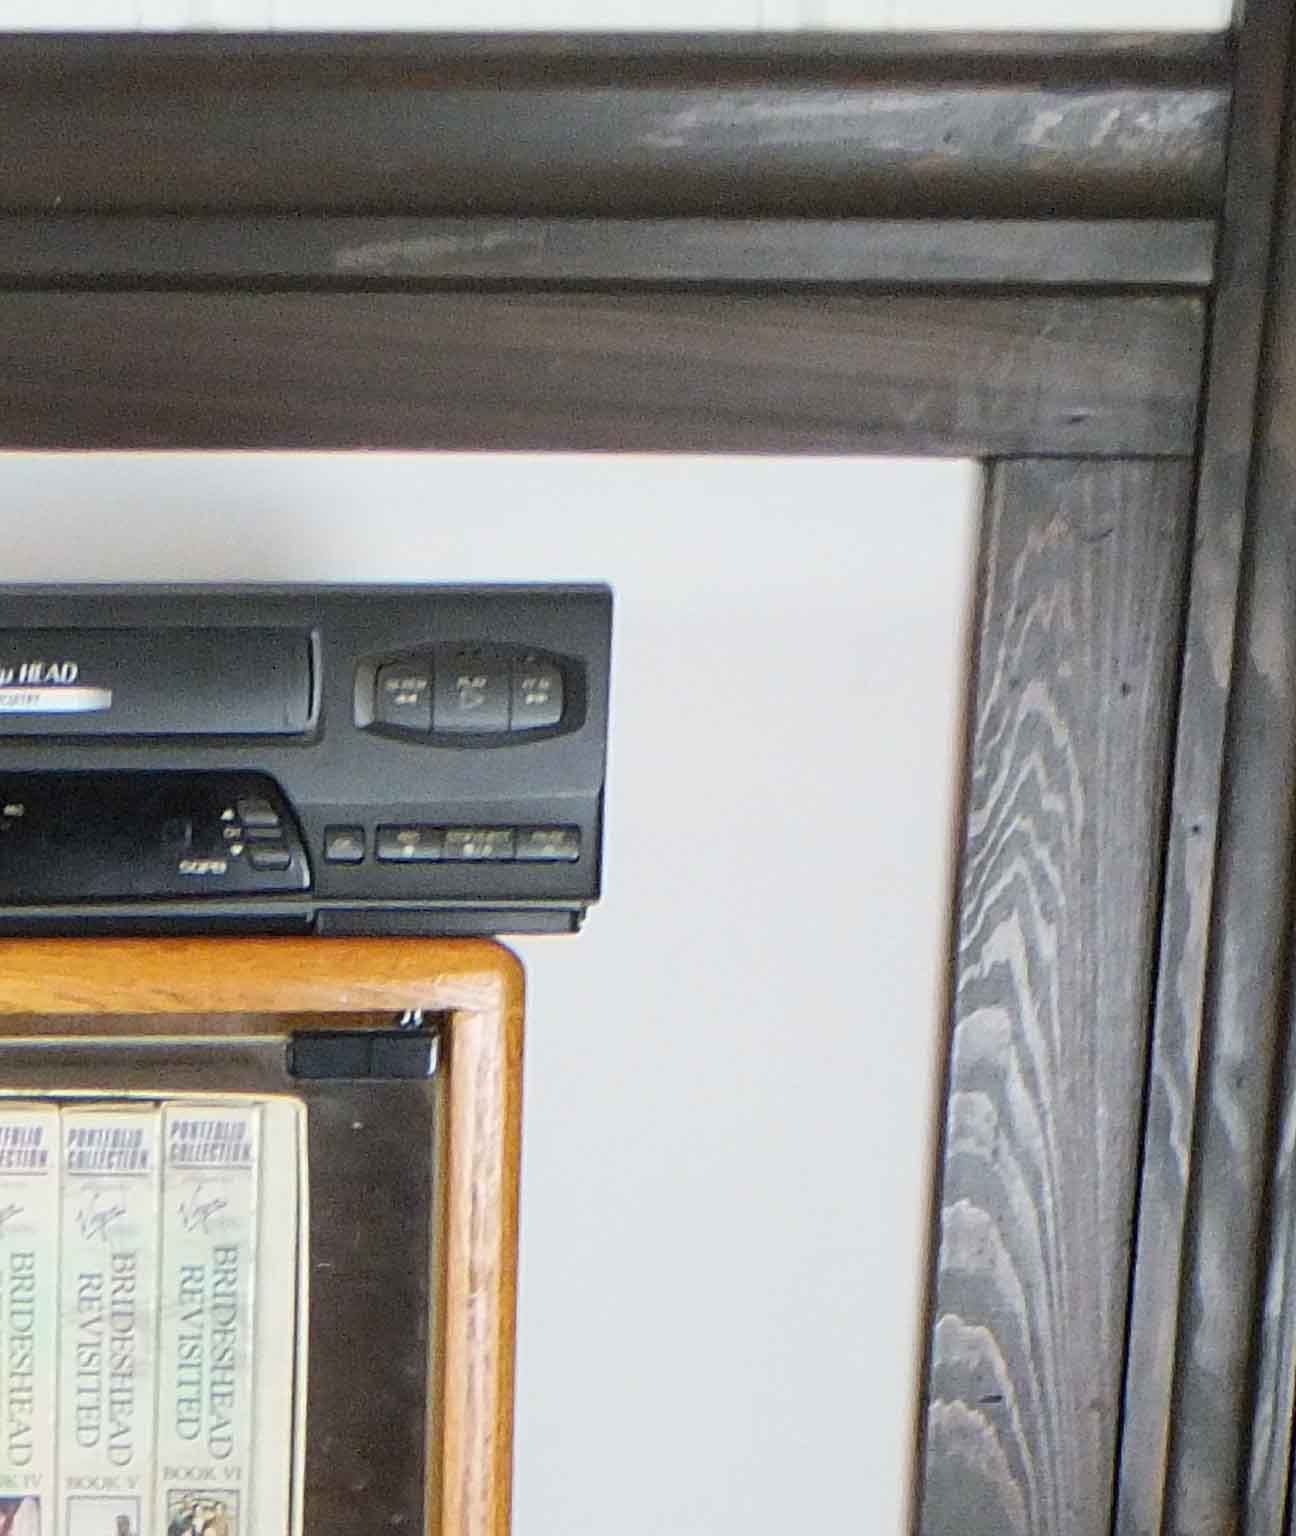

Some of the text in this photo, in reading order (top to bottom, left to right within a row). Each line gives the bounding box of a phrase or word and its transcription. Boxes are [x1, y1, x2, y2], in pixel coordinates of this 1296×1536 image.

[18, 663, 79, 685] HEAD
[67, 1127, 144, 1149] PORTFOLIO
[170, 1120, 247, 1141] PORTFOLIO
[67, 1150, 149, 1170] COLLECTION
[170, 1142, 251, 1163] COLLECTION
[7, 1251, 36, 1468] BRIDESHEAD
[75, 1272, 104, 1449] REVISITED
[106, 1251, 137, 1467] BRIDESHEAD
[175, 1264, 204, 1442] REVISITED
[206, 1245, 239, 1461] BRIDESHEAD
[65, 1476, 120, 1489] BOOK
[162, 1466, 212, 1481] BOOK
